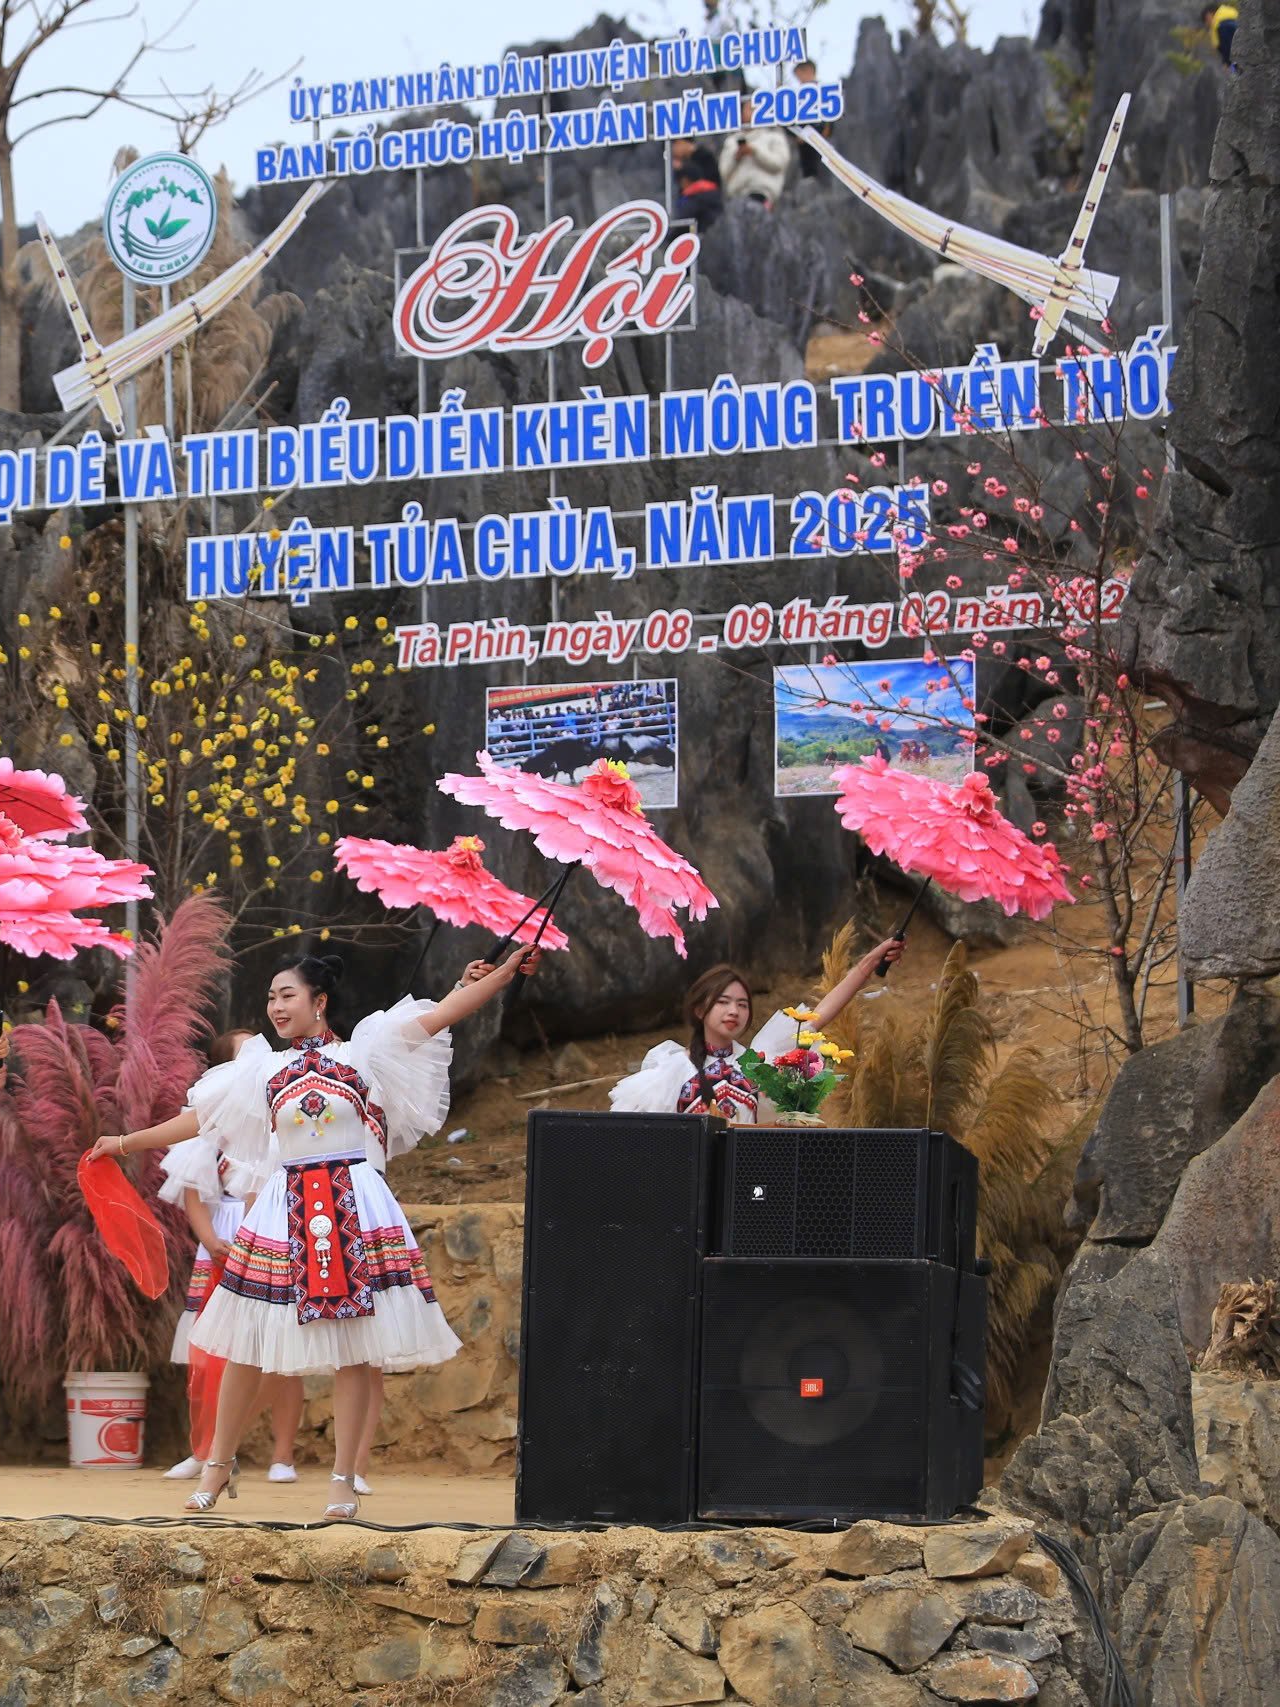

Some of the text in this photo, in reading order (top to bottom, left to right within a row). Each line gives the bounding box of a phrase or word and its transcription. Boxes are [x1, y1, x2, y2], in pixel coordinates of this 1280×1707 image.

[289, 76, 323, 122] ỦY
[331, 77, 389, 115] BAN
[396, 63, 476, 107] NHÂN
[483, 54, 542, 97] DÂN
[550, 39, 648, 91] HUYỆN
[657, 28, 715, 76] TỦA
[256, 84, 842, 183] BAN TỔ CHỨC HỘI XUÂN NĂM 2025
[398, 205, 696, 366] Hội
[48, 433, 103, 505] DÊ
[184, 433, 255, 494] THI
[270, 399, 376, 487] BIỂU
[388, 391, 500, 478] DIỄN
[515, 388, 647, 468] KHÈN
[663, 379, 814, 454] MÔNG
[833, 344, 1038, 440] TRUYỀN
[189, 487, 929, 604] HUYỆN TỦA CHÙA, NĂM 2025
[397, 625, 440, 665] Tả
[448, 618, 537, 664] Phìn,
[545, 611, 638, 661] ngày
[645, 612, 691, 650] 08
[727, 606, 771, 646] 09
[783, 597, 892, 645] tháng
[901, 594, 947, 638] 02
[956, 589, 1041, 628] năm
